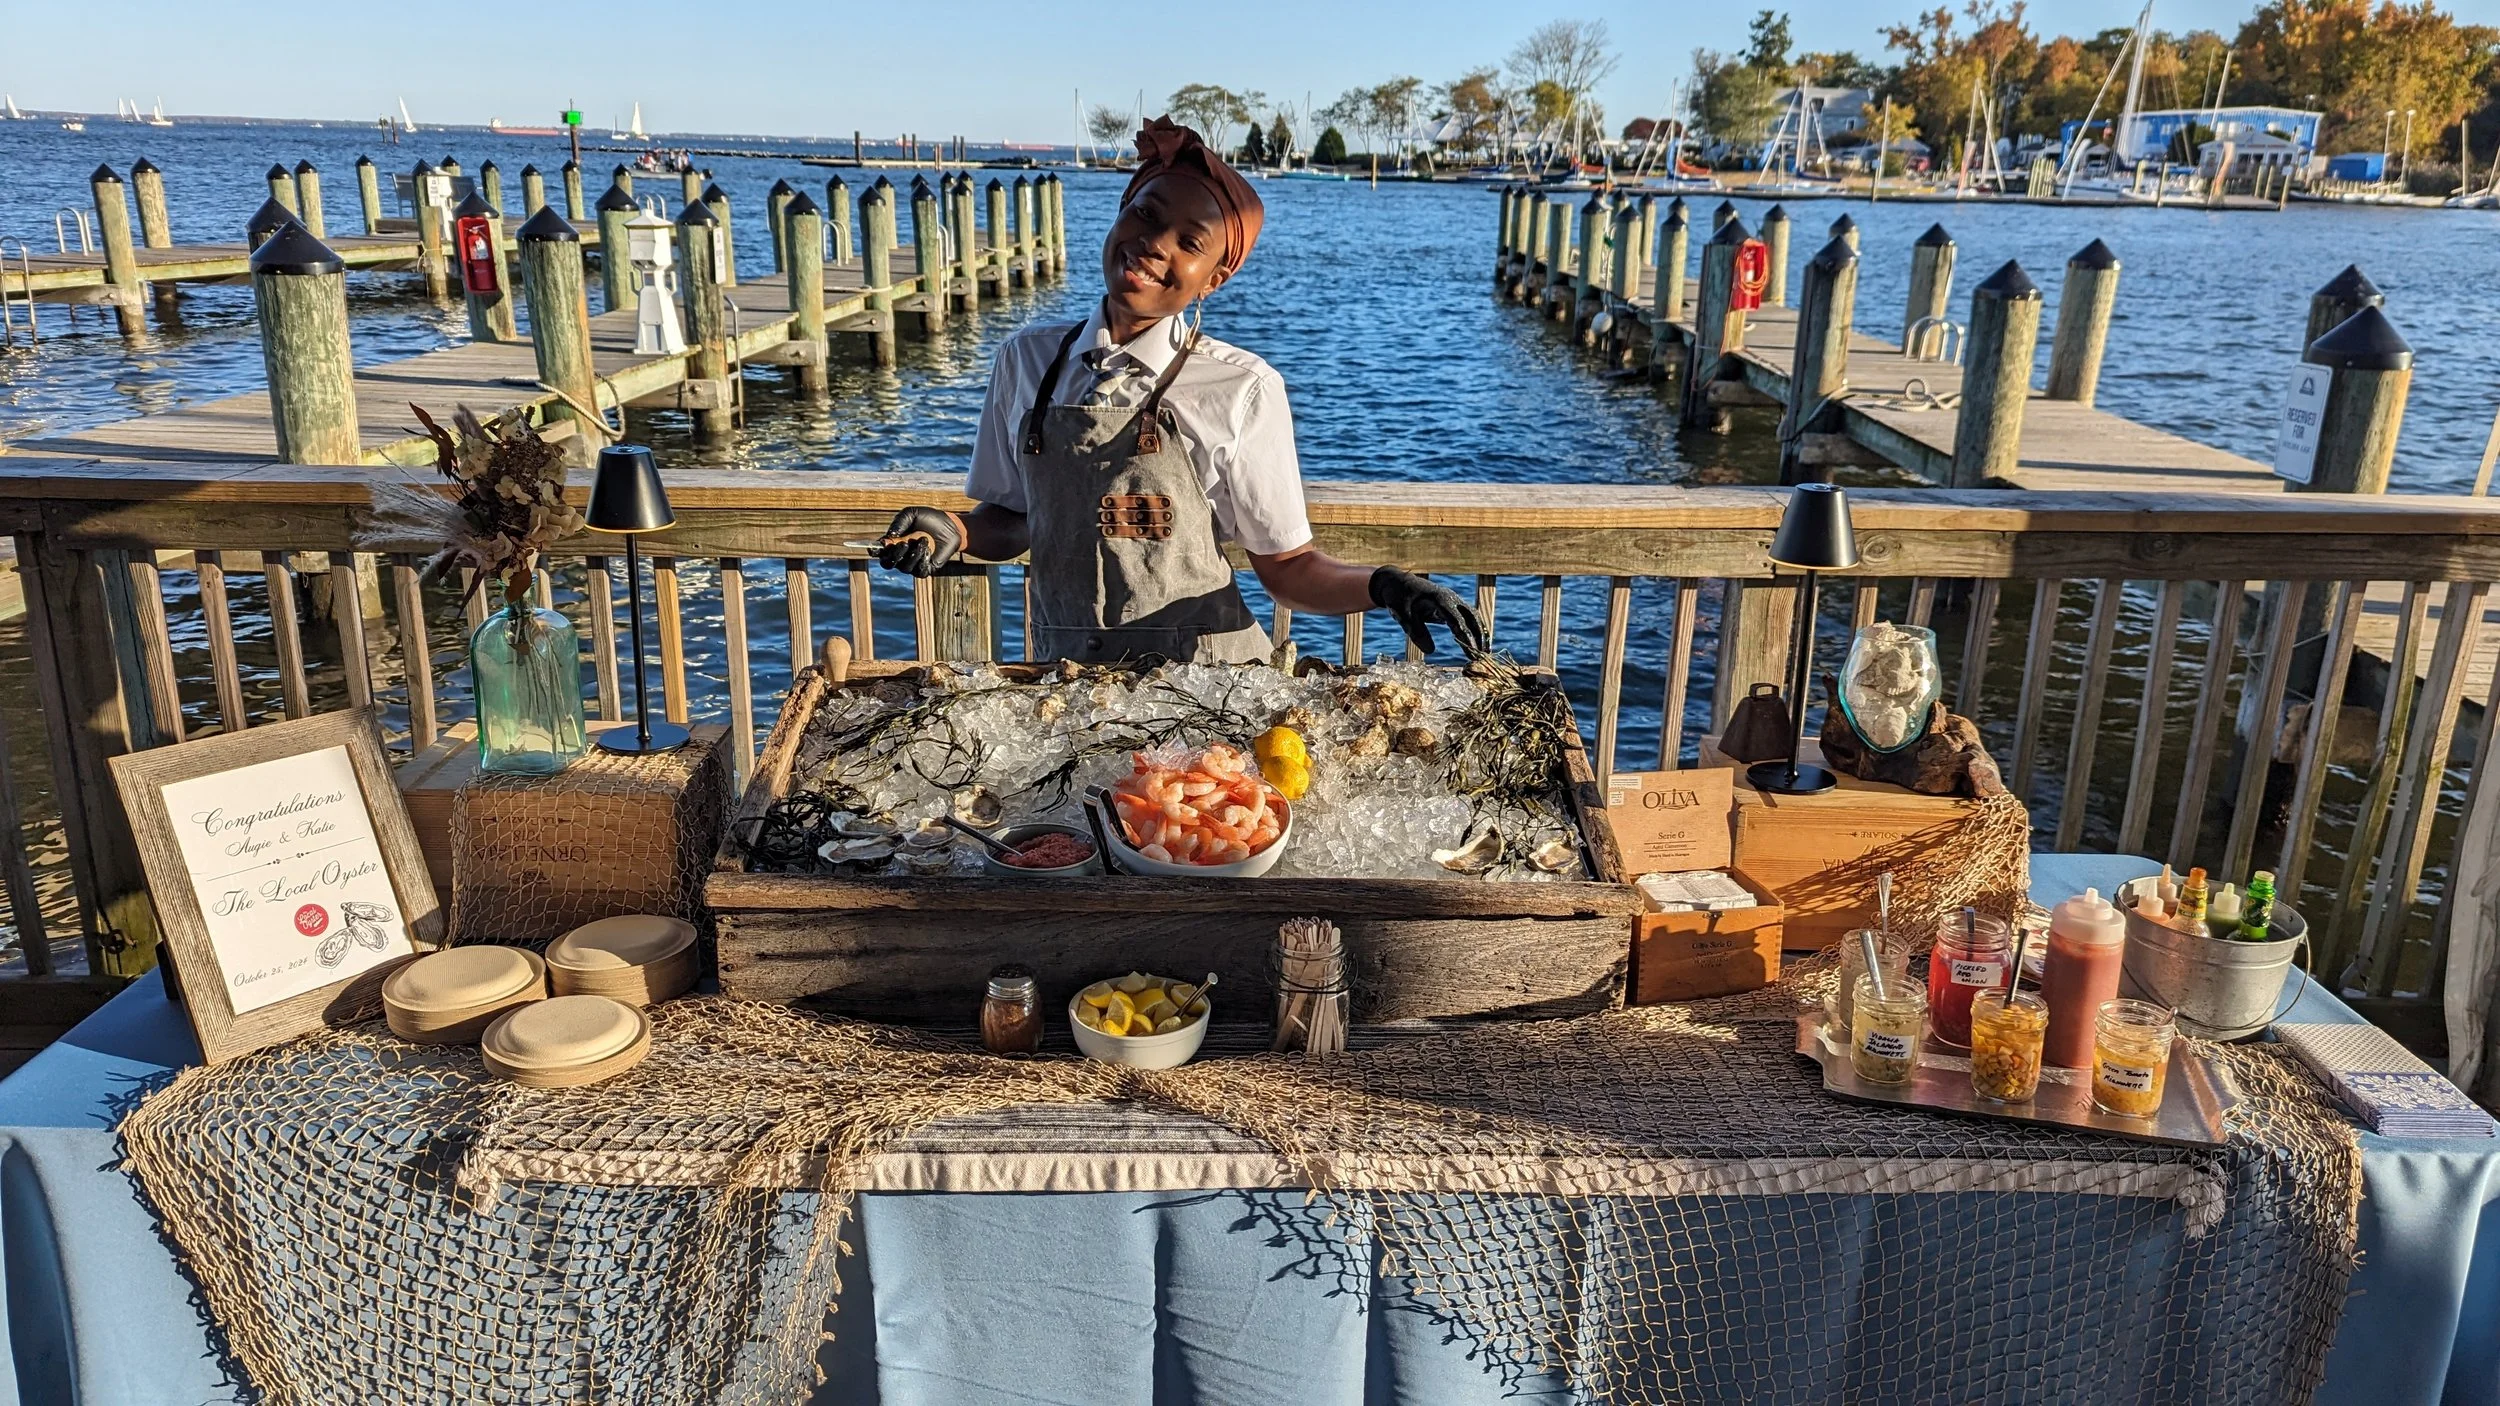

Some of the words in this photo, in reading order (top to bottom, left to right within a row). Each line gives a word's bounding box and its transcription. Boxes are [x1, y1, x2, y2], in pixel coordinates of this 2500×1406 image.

[2287, 407, 2317, 426] RESERVED
[2292, 424, 2305, 439] FOR
[1642, 788, 1700, 809] OLIVA
[191, 790, 346, 837] Congratulations
[225, 837, 273, 858] Augie
[279, 831, 291, 844] &
[296, 818, 337, 839] Katie
[1658, 831, 1677, 840] Serie
[1677, 831, 1685, 839] G
[1860, 831, 1899, 841] SOLARE
[472, 845, 587, 862] ORNELLAIA
[212, 888, 256, 916] The
[259, 870, 321, 903] Local
[321, 860, 379, 889] Oyster
[233, 969, 267, 987] October
[271, 966, 284, 976] 25,
[288, 956, 308, 970] 2024
[1955, 963, 1987, 973] PICKLED
[2102, 1062, 2120, 1074] Green
